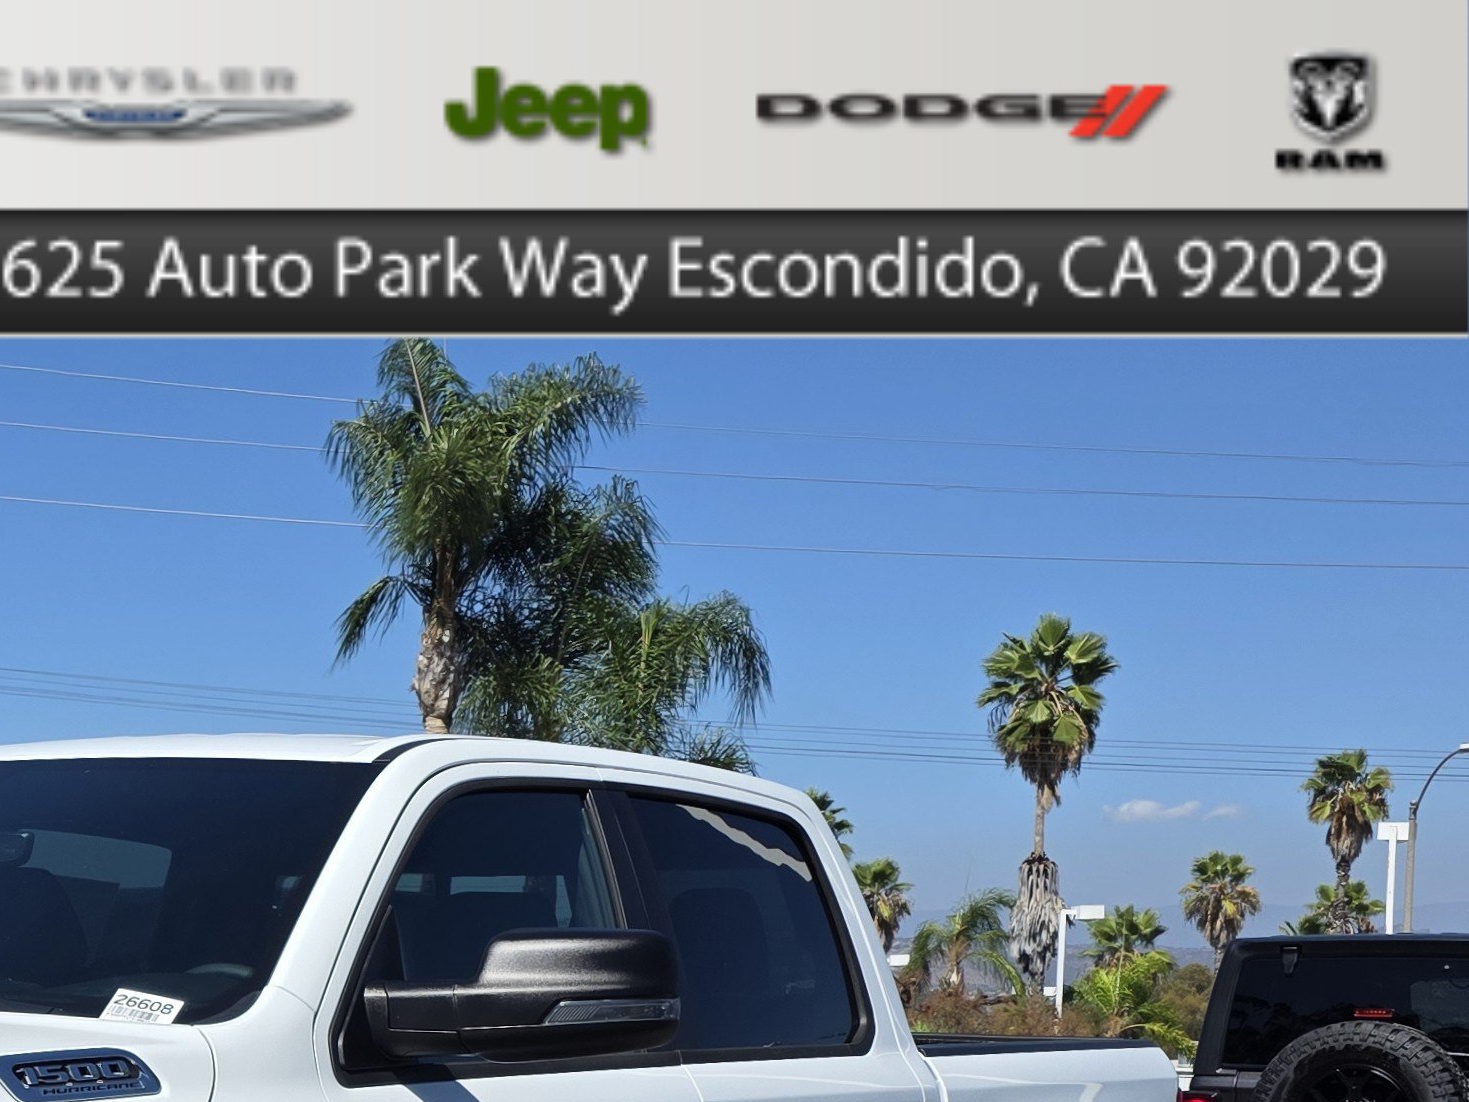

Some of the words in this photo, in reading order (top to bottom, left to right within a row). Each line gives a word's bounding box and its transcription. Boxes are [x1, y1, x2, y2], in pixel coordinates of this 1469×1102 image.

[114, 994, 174, 1015] 26608
[15, 1059, 130, 1087] 1500
[42, 1080, 141, 1096] HURRICANE
